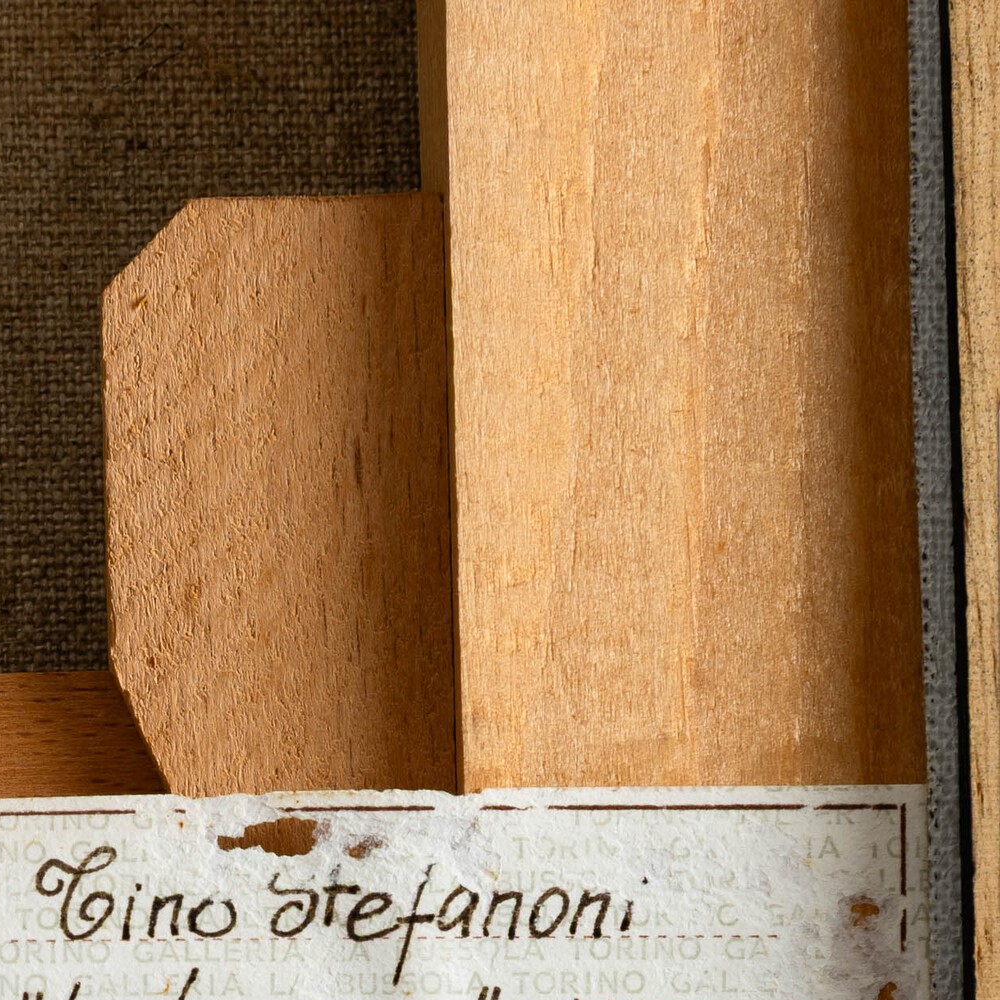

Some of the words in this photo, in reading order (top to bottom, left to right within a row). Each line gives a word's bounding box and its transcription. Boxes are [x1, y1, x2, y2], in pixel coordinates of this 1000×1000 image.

[35, 845, 238, 941] Tino
[131, 938, 305, 965] GALLERIA
[569, 936, 702, 961] TORINO
[512, 969, 647, 995] TORINO
